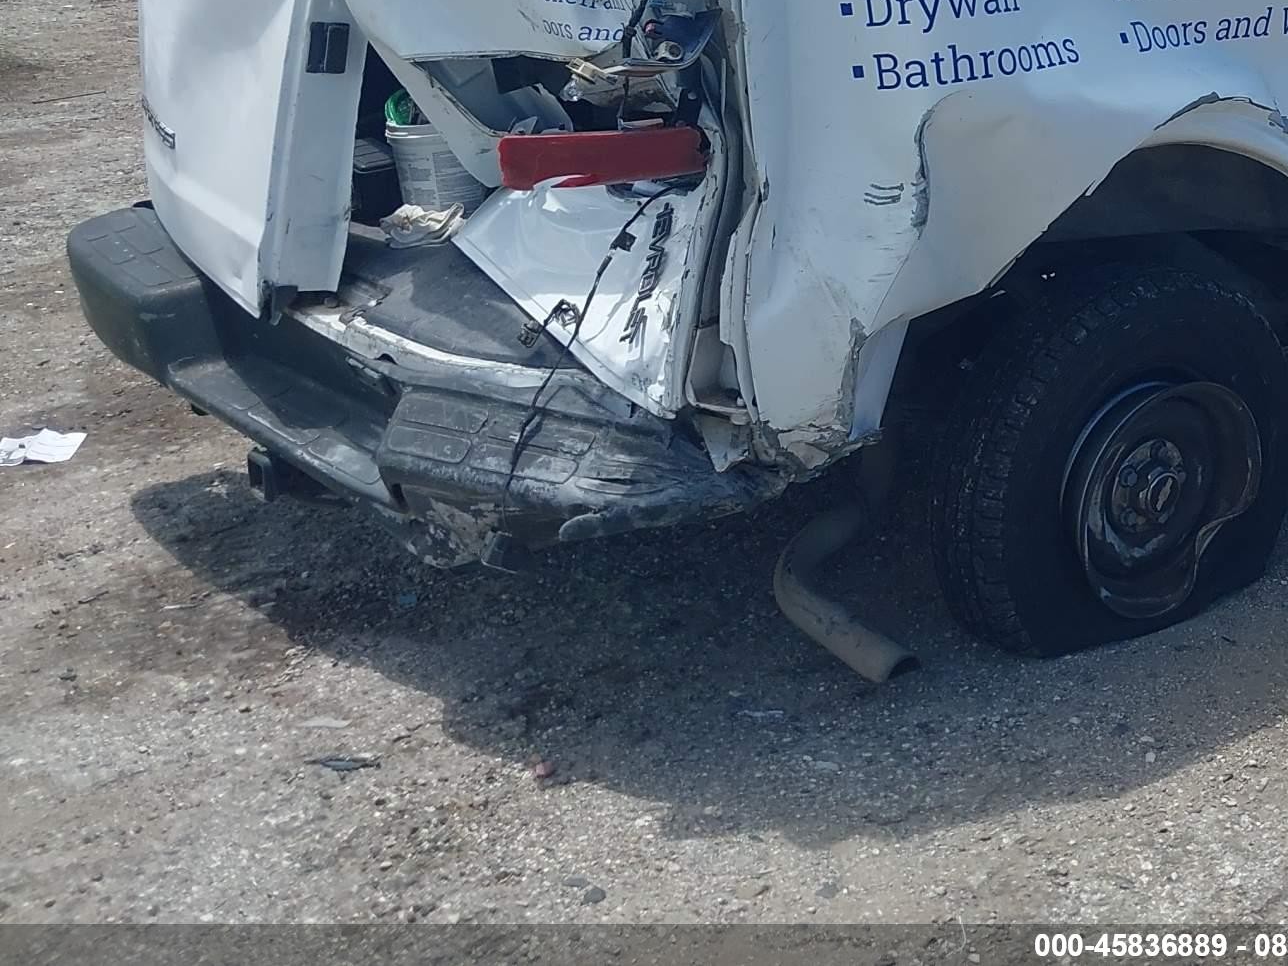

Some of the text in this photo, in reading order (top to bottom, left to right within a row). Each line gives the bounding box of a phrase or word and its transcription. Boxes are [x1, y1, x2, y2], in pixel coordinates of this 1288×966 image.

[1130, 20, 1208, 53] Doors
[1215, 6, 1273, 42] and
[872, 37, 1080, 91] Bathrooms
